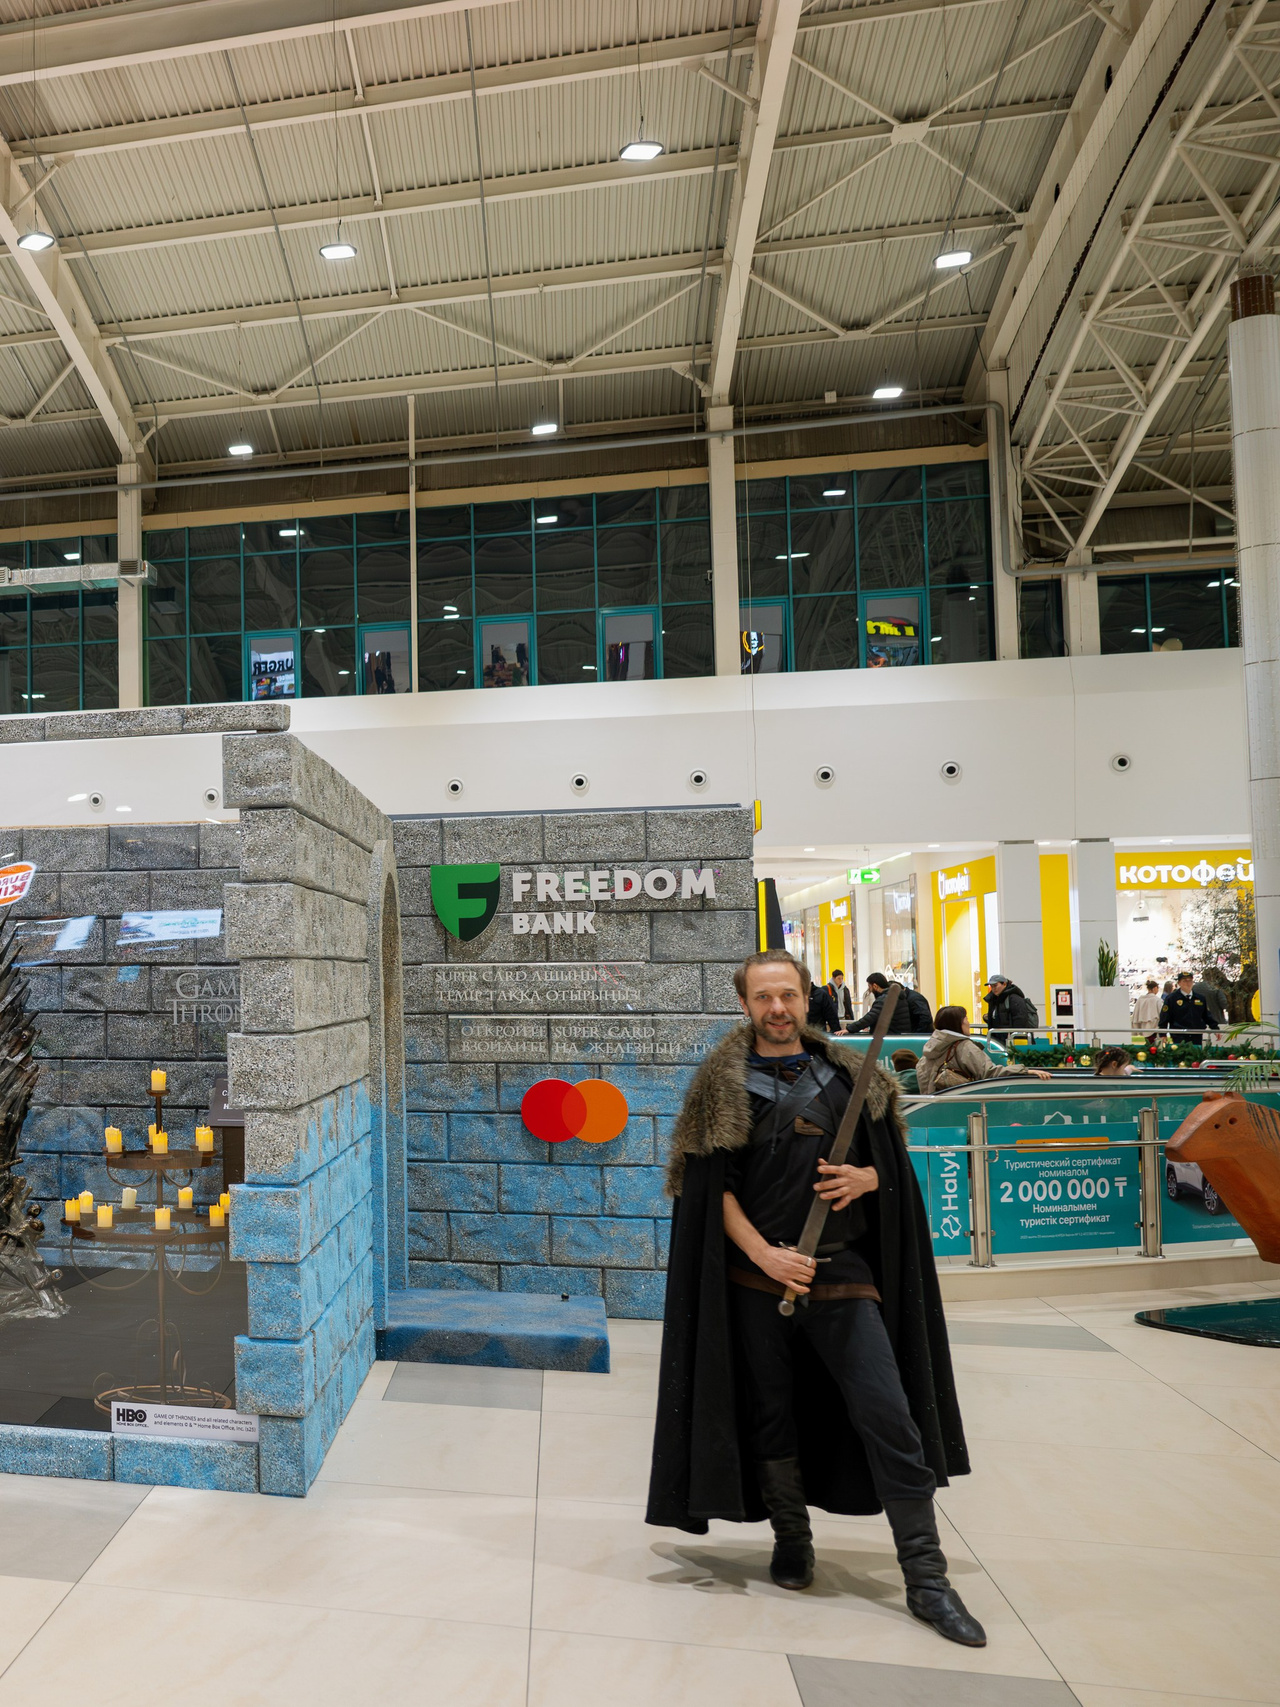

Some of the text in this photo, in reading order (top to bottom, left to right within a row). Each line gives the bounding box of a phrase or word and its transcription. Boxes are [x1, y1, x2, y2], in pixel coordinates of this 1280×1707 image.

[1119, 857, 1255, 886] котофей
[512, 869, 716, 902] FREEDOM
[512, 911, 597, 935] BANK
[435, 970, 478, 982] SUPER
[482, 970, 527, 982] CARD
[176, 973, 240, 999] GAM
[554, 1025, 599, 1038] SUPER
[608, 1026, 655, 1038] CARD
[1004, 1156, 1121, 1171] Туристический сертификат
[1039, 1168, 1089, 1178] номиналом
[1000, 1181, 1014, 1203] 2
[1018, 1179, 1062, 1202] 000
[1067, 1177, 1110, 1200] 000
[1033, 1202, 1097, 1213] Номиналымен
[1020, 1214, 1111, 1227] туристік сертификат
[116, 1407, 147, 1423] HBO
